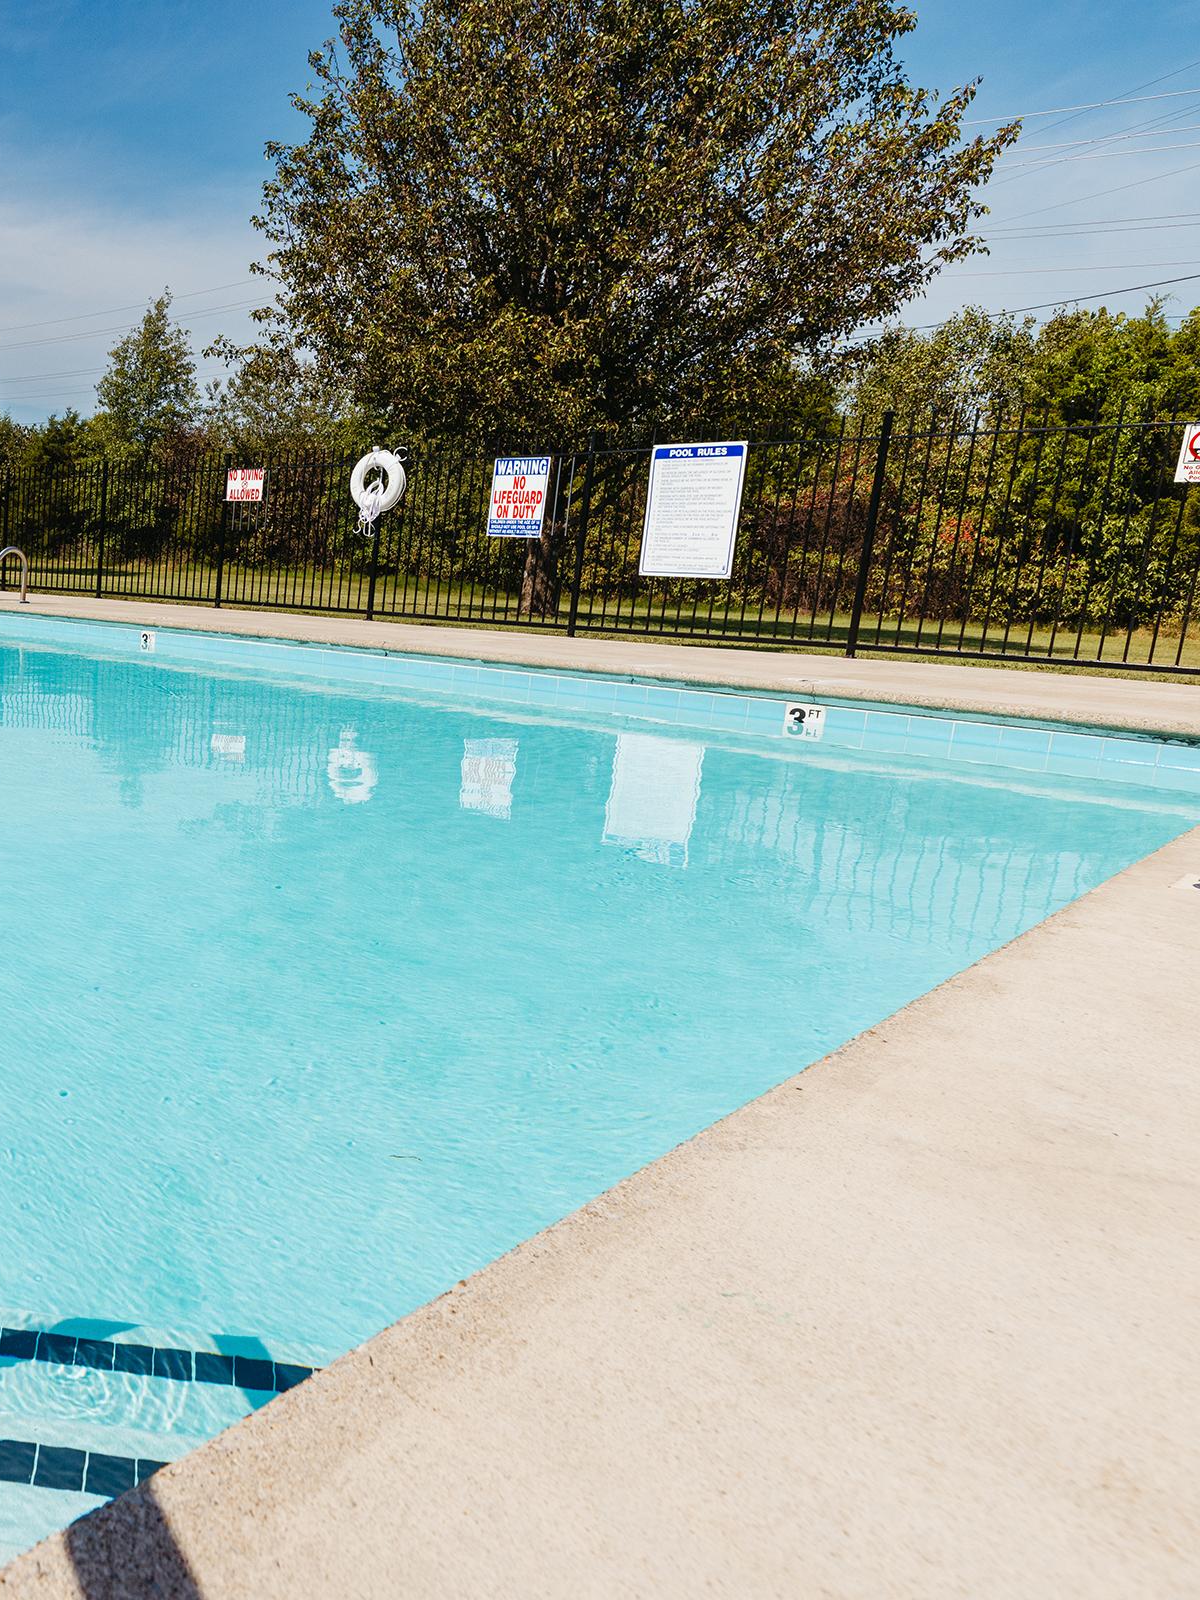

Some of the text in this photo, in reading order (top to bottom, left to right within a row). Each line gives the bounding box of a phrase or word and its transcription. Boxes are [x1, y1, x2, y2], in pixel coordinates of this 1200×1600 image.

[669, 447, 728, 457] POOL RULES
[497, 460, 547, 475] WARNING
[229, 469, 263, 481] NO DIVING
[513, 476, 526, 490] NO
[229, 489, 260, 500] ALLOWED
[493, 491, 543, 505] LIFEGUARD
[496, 505, 537, 519] ON DUTY
[808, 709, 821, 719] FT
